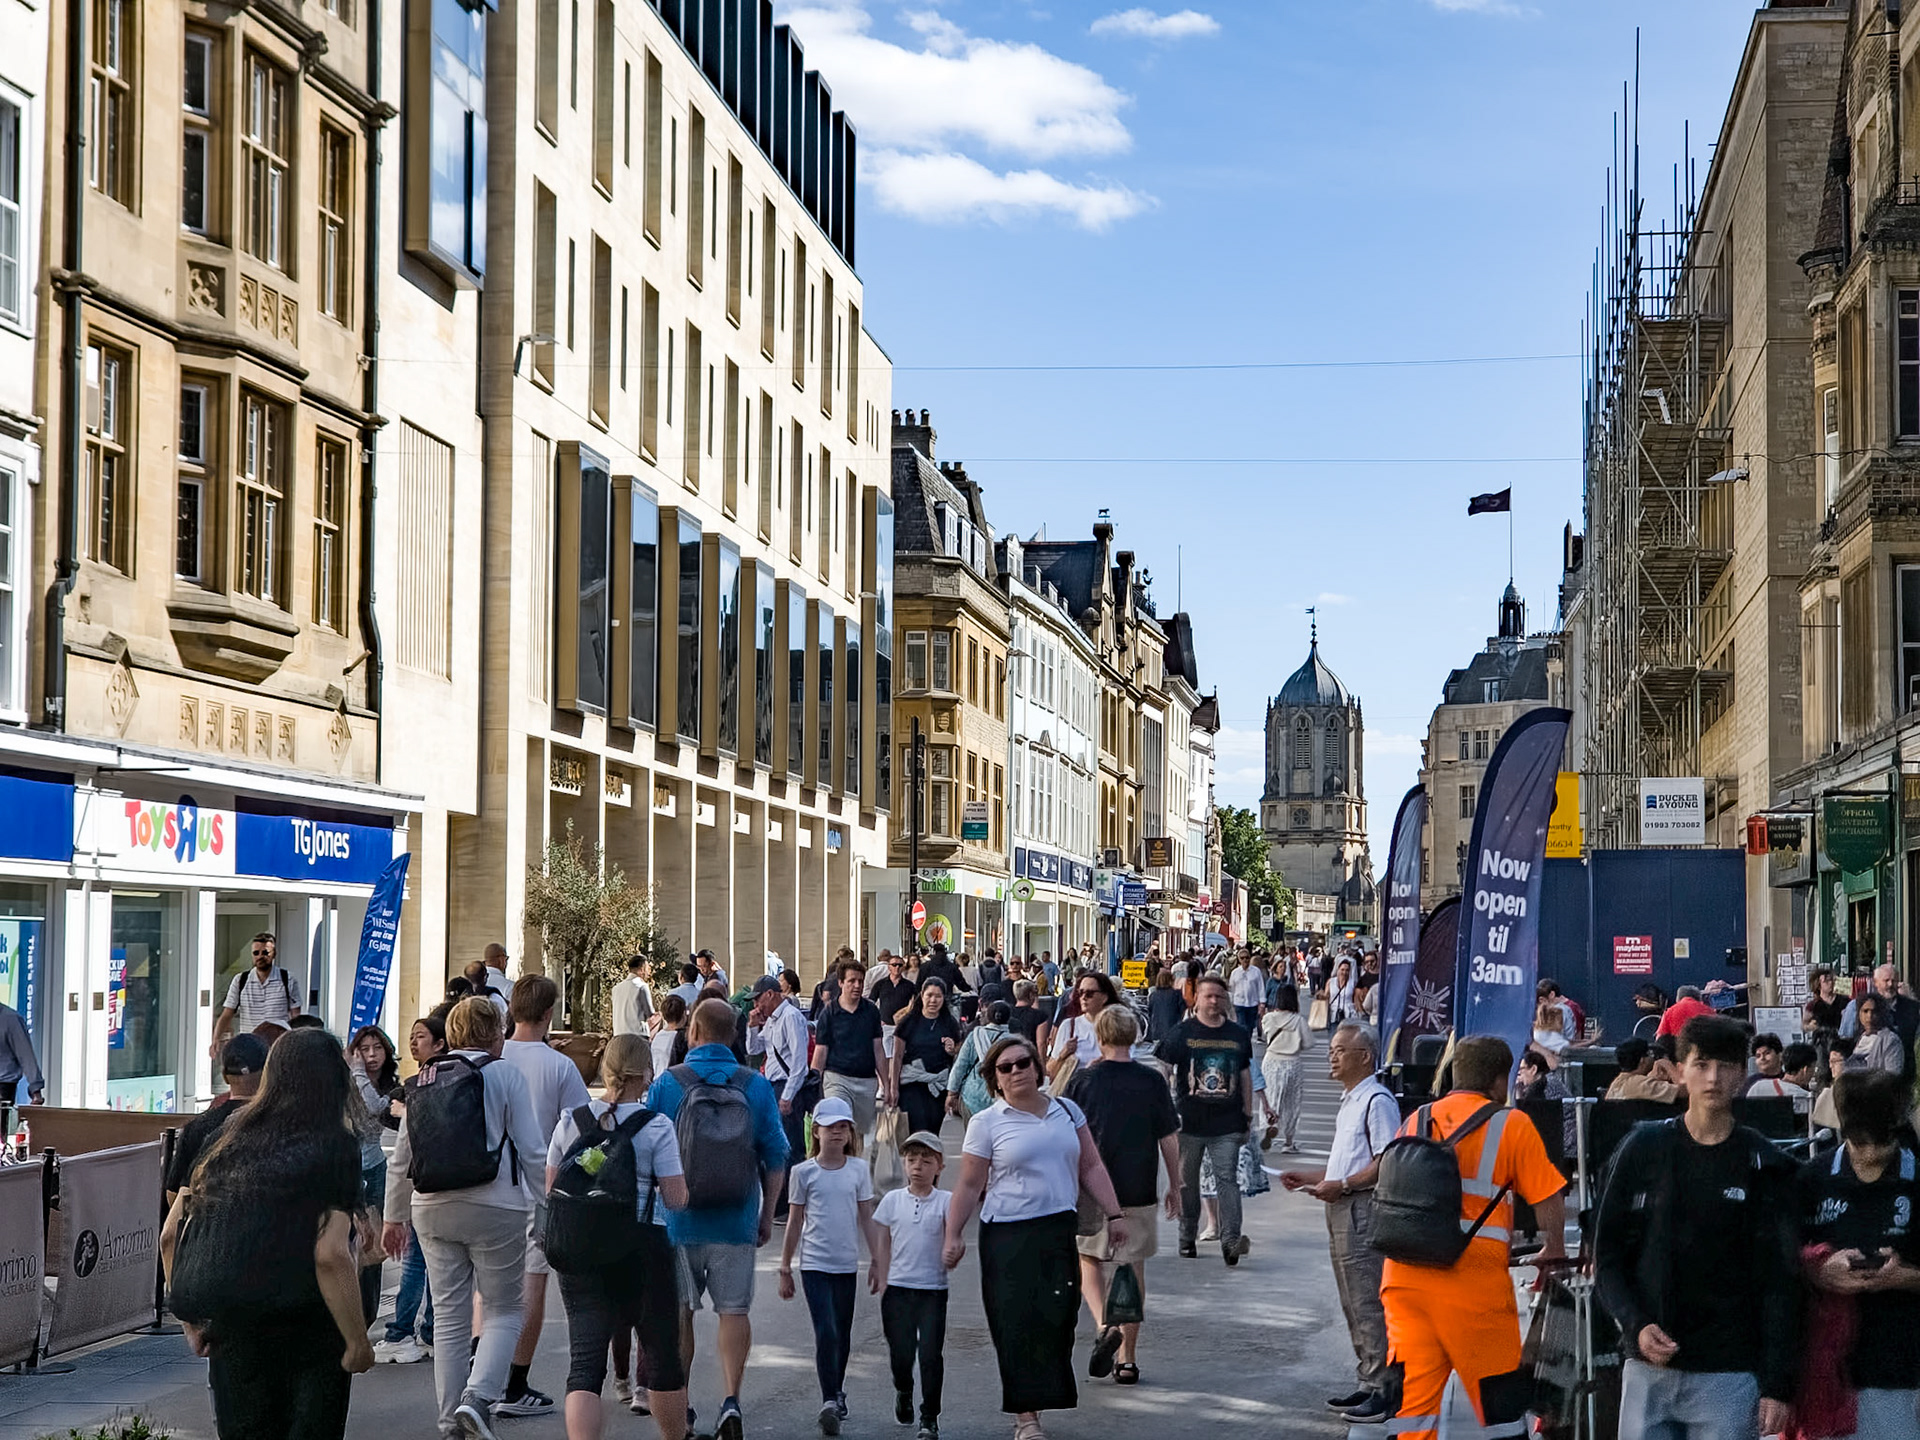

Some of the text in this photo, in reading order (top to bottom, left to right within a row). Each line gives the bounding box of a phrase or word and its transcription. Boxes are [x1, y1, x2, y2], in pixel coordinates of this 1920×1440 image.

[1840, 809, 1875, 817] OFFICIAL
[291, 819, 350, 865] TGJones
[1481, 849, 1531, 881] Now
[1474, 890, 1527, 920] open
[1488, 925, 1509, 954] til
[1471, 955, 1523, 986] 3am
[1893, 1196, 1911, 1227] 3
[100, 1219, 154, 1261] Amorino
